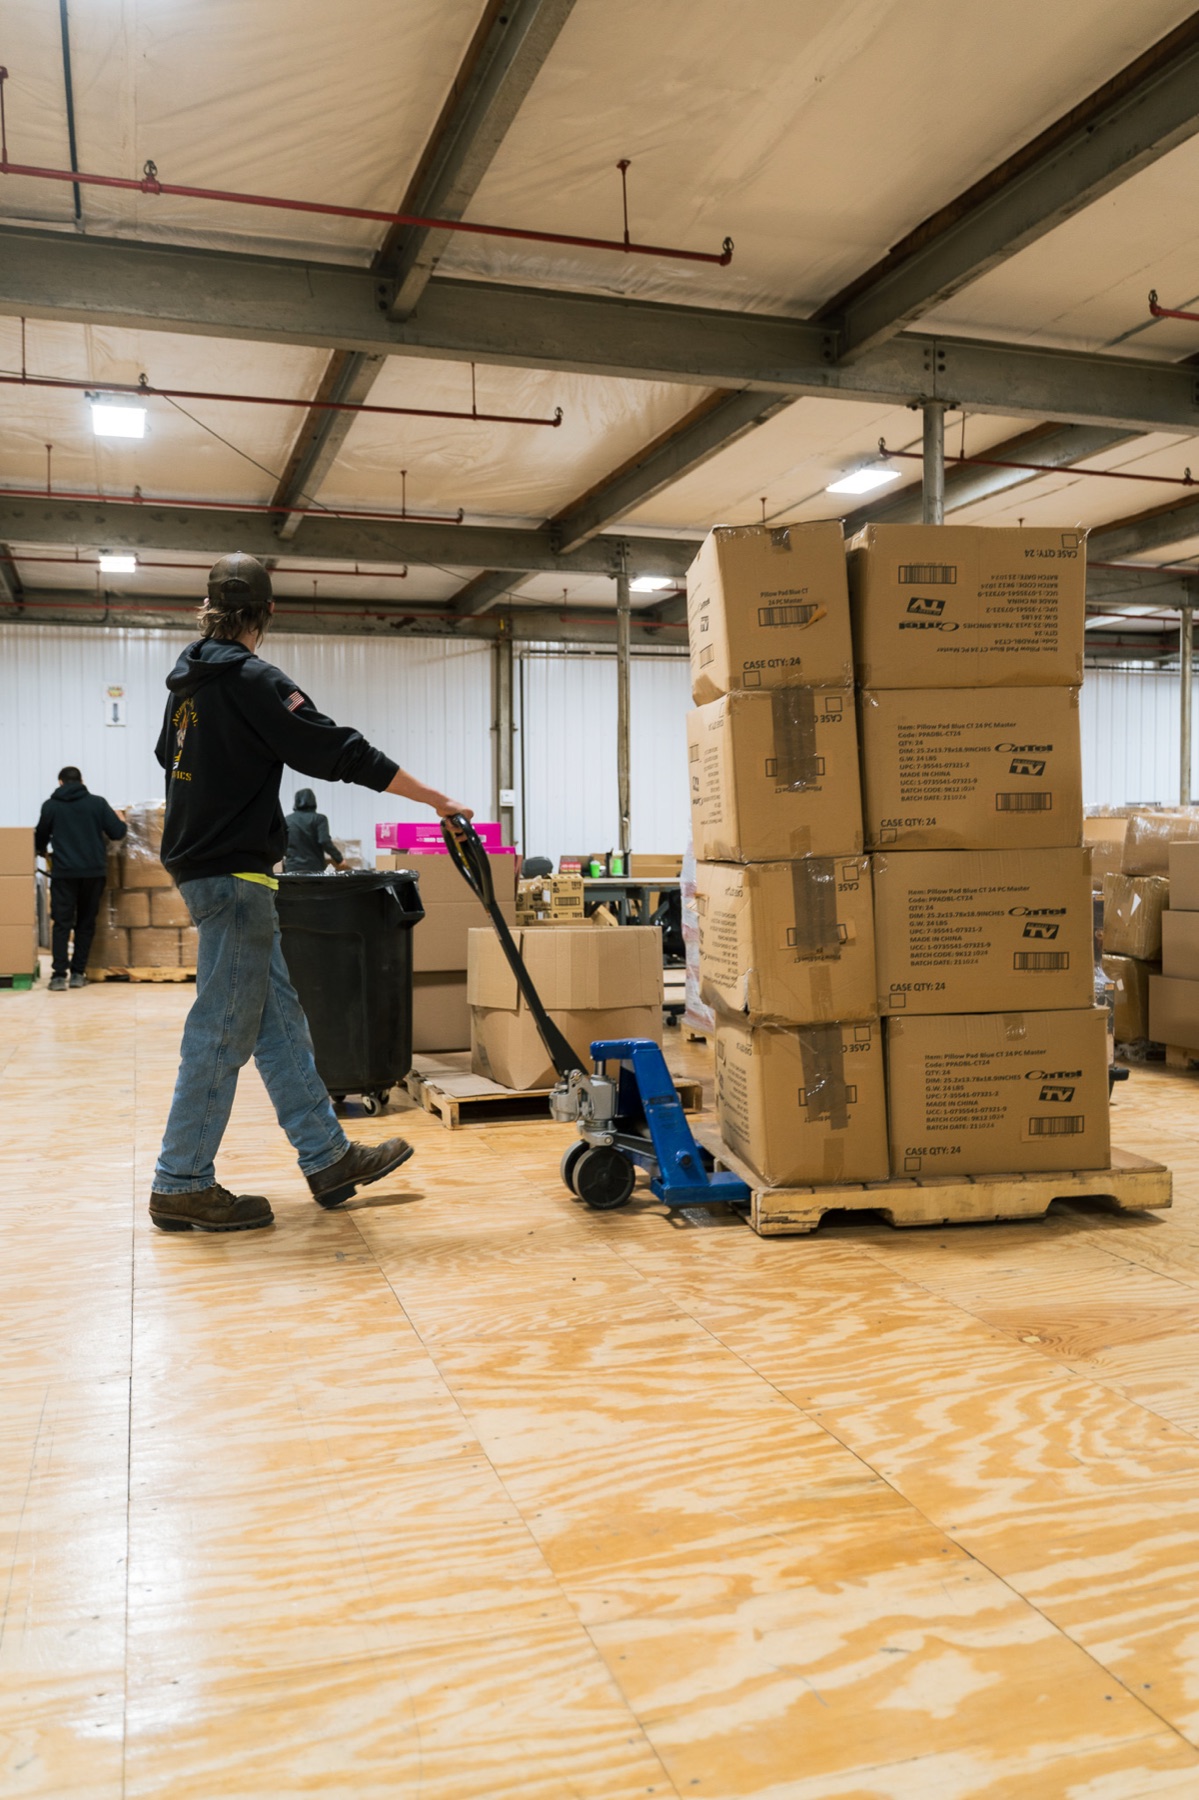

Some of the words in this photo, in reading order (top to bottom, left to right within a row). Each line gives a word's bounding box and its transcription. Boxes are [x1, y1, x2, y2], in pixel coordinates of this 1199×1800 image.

[1025, 550, 1034, 558] 24
[1036, 549, 1055, 558] QTY:
[1056, 550, 1077, 558] CASE
[910, 598, 943, 611] TV
[743, 660, 765, 670] CASE
[768, 658, 788, 667] QTY:
[790, 657, 801, 666] 24
[820, 714, 842, 723] CASE
[1013, 764, 1043, 775] TV
[881, 819, 902, 827] CASE
[926, 818, 936, 826] 24
[838, 882, 859, 891] CASE
[1026, 927, 1057, 938] TV
[914, 983, 933, 991] QTY:
[849, 1043, 870, 1052] CASE
[1042, 1091, 1073, 1102] TV
[905, 1148, 927, 1156] CASE
[929, 1147, 949, 1155] QTY:
